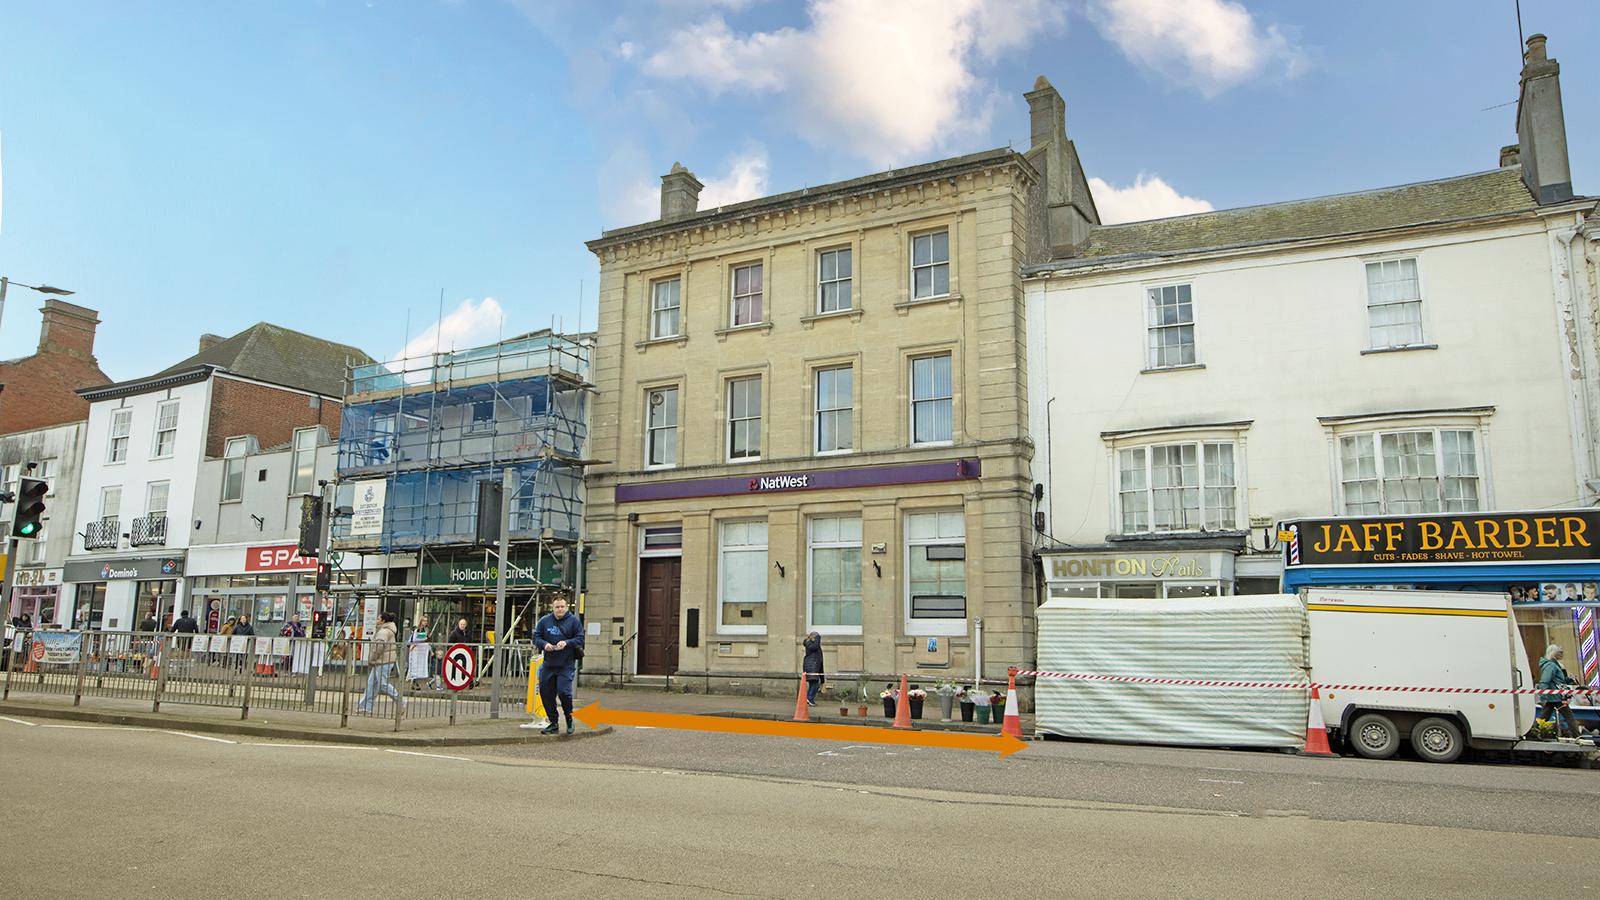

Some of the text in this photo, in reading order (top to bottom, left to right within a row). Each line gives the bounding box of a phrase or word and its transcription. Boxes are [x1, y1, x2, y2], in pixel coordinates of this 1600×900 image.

[760, 475, 808, 489] NatWest
[1313, 517, 1592, 553] JAFF BARBER
[1373, 553, 1395, 561] CUTS
[1401, 552, 1429, 560] FADES
[1435, 551, 1465, 560] SHAVE
[1471, 551, 1490, 559] HOT
[1491, 551, 1525, 559] TOWEL
[1052, 554, 1204, 577] HONITON Nails
[109, 568, 138, 578] Domino's
[452, 568, 490, 580] Holland
[505, 567, 534, 579] arrett
